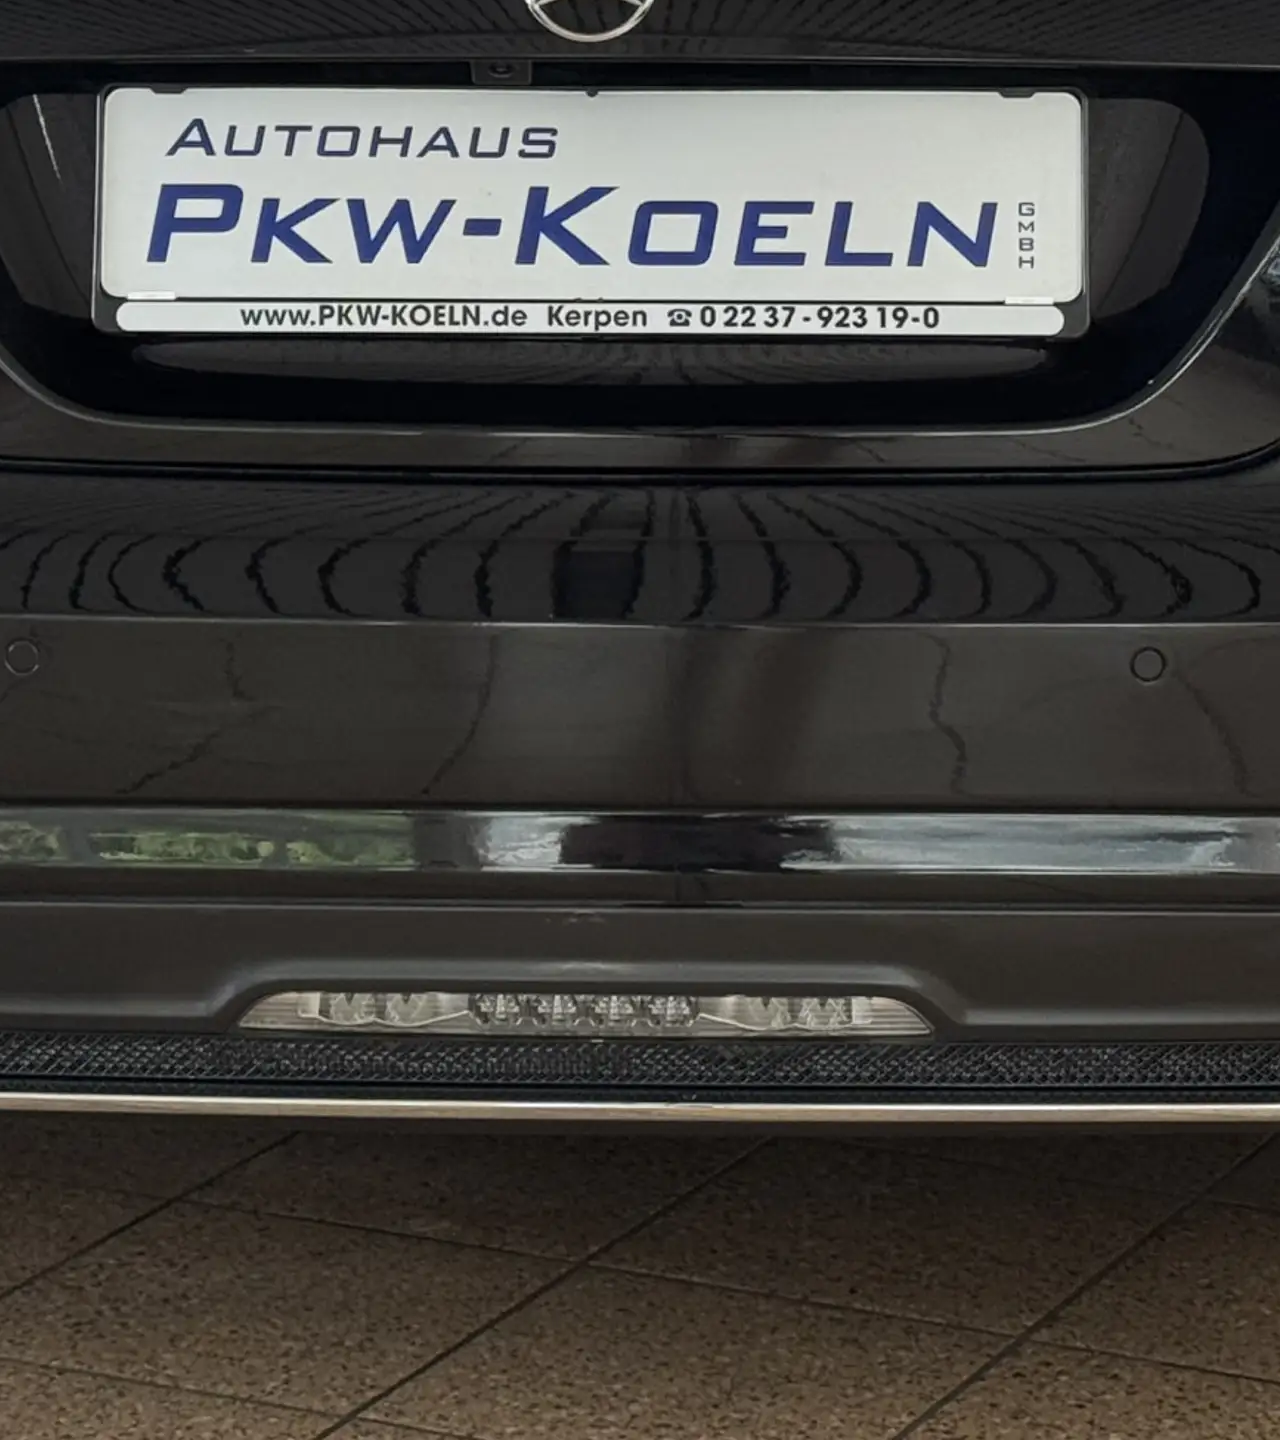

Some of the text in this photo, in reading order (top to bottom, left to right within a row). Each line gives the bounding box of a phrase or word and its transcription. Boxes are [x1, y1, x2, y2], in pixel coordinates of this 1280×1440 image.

[1017, 201, 1037, 270] GMBH
[239, 304, 529, 328] www.PKW-KOELN.de
[546, 304, 648, 332] Kerpen
